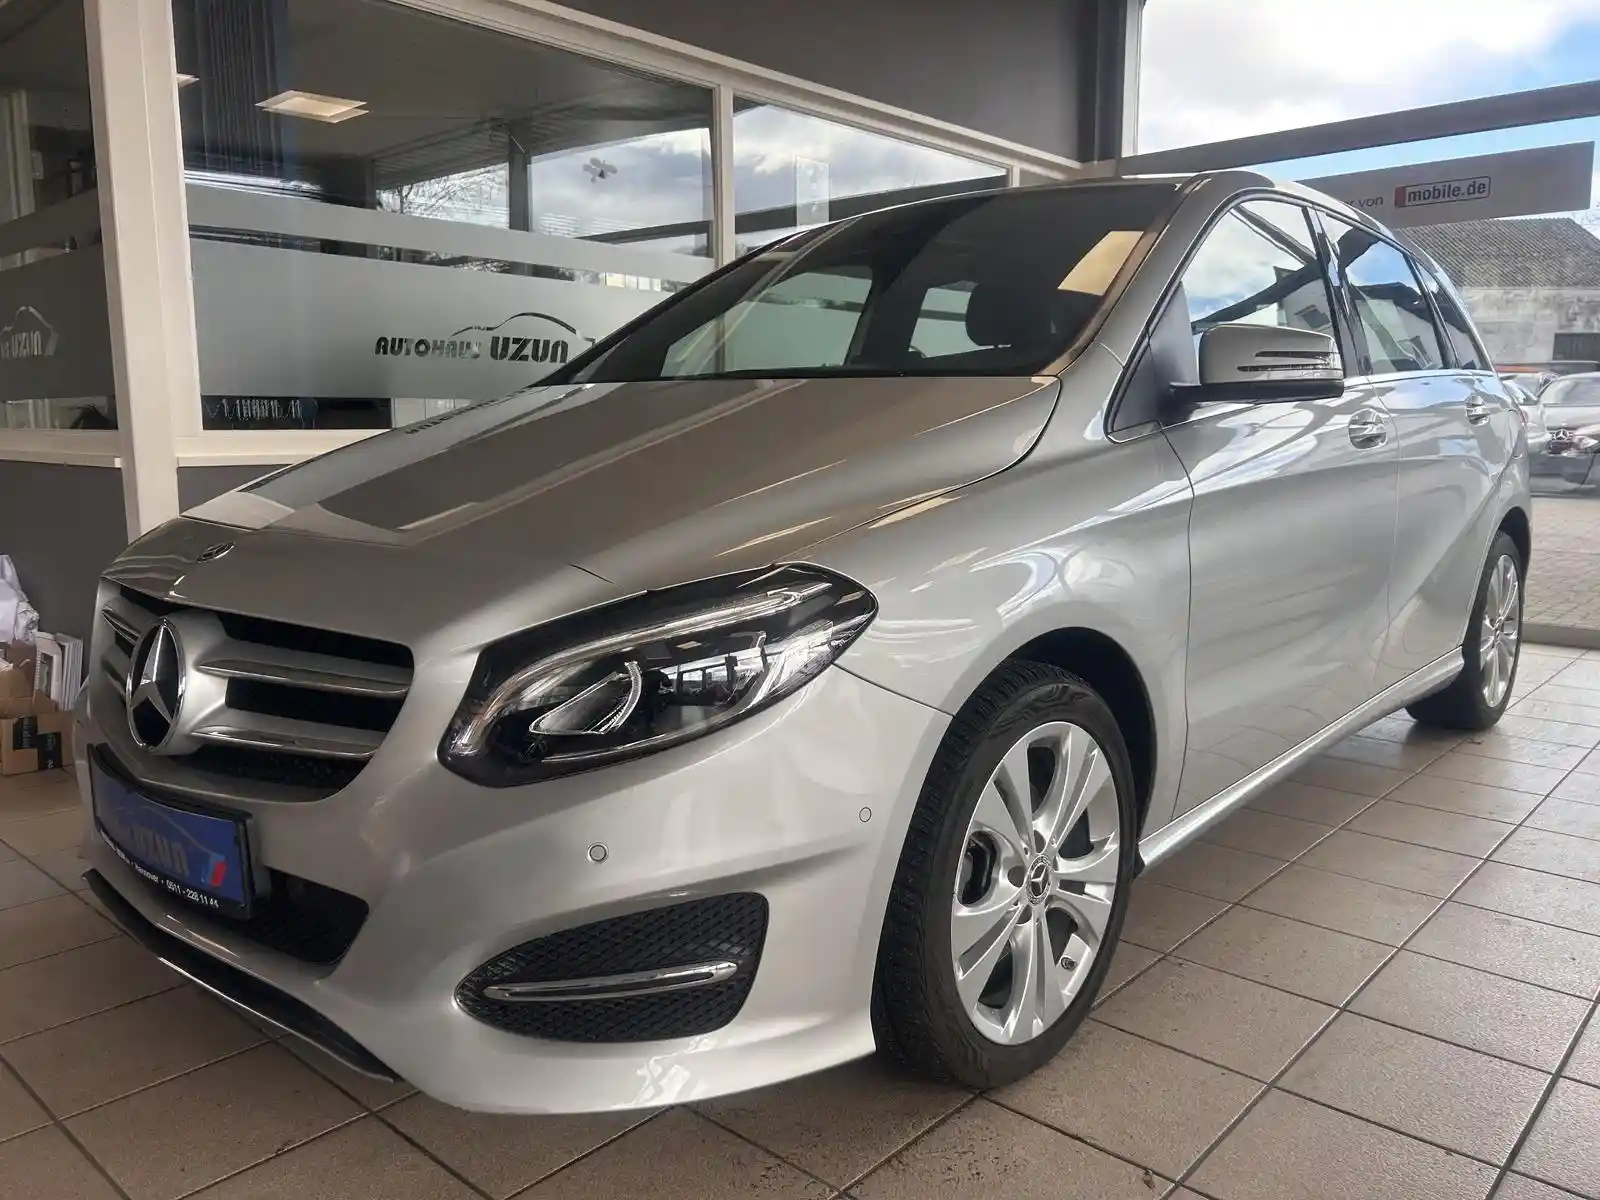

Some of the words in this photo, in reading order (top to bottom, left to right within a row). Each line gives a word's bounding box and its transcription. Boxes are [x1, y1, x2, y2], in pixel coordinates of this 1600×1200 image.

[1358, 196, 1384, 209] von
[1407, 180, 1486, 203] mobile.de
[489, 335, 569, 364] UZUN
